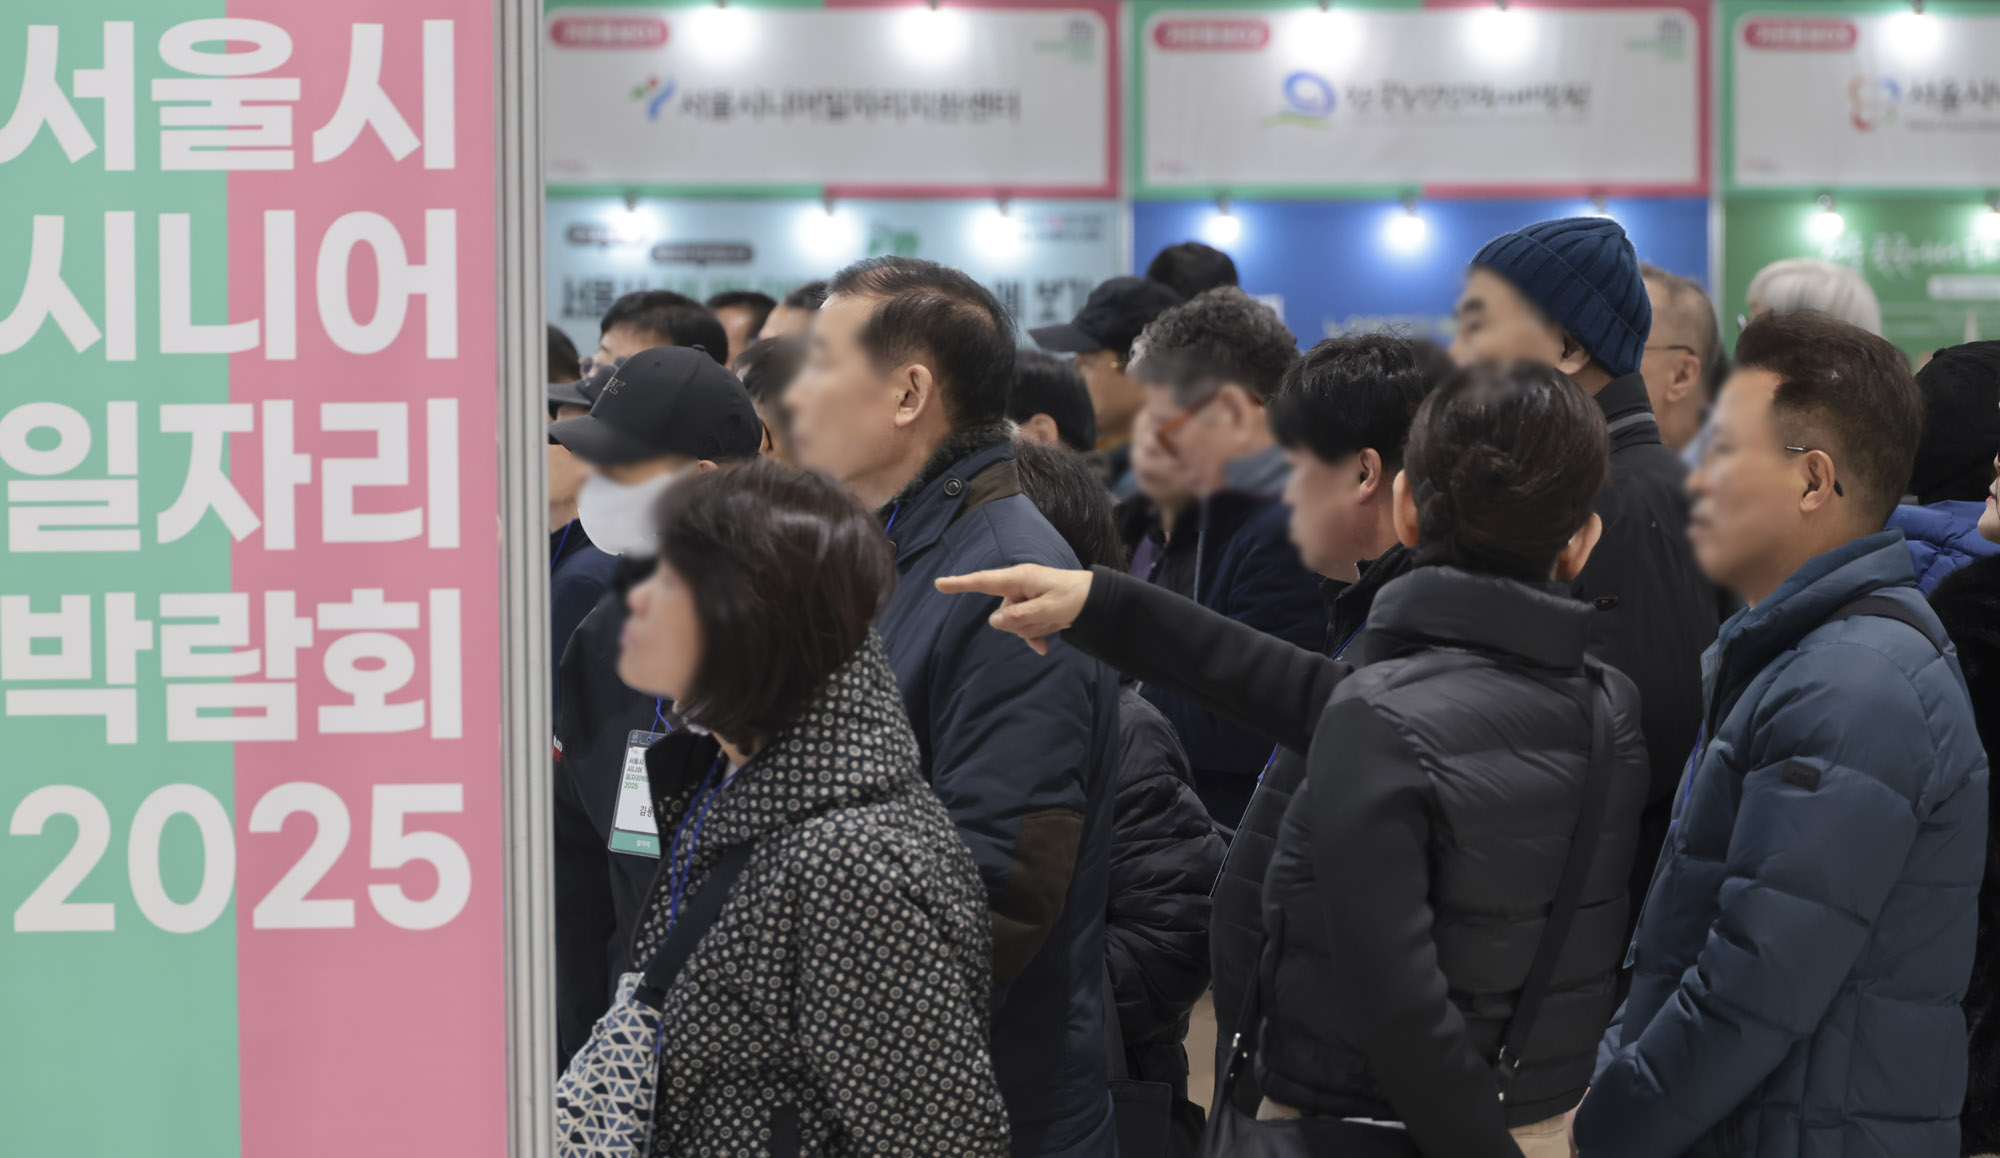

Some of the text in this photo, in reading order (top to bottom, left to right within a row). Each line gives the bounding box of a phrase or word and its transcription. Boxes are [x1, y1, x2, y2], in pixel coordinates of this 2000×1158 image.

[0, 18, 455, 171] 서울시
[0, 208, 459, 362] 시니어
[0, 398, 460, 553] 일자리
[1, 588, 463, 744] 박람회
[624, 781, 639, 789] 2025
[626, 765, 643, 774] 시니어
[627, 757, 644, 766] 서울시
[9, 781, 472, 934] 2025
